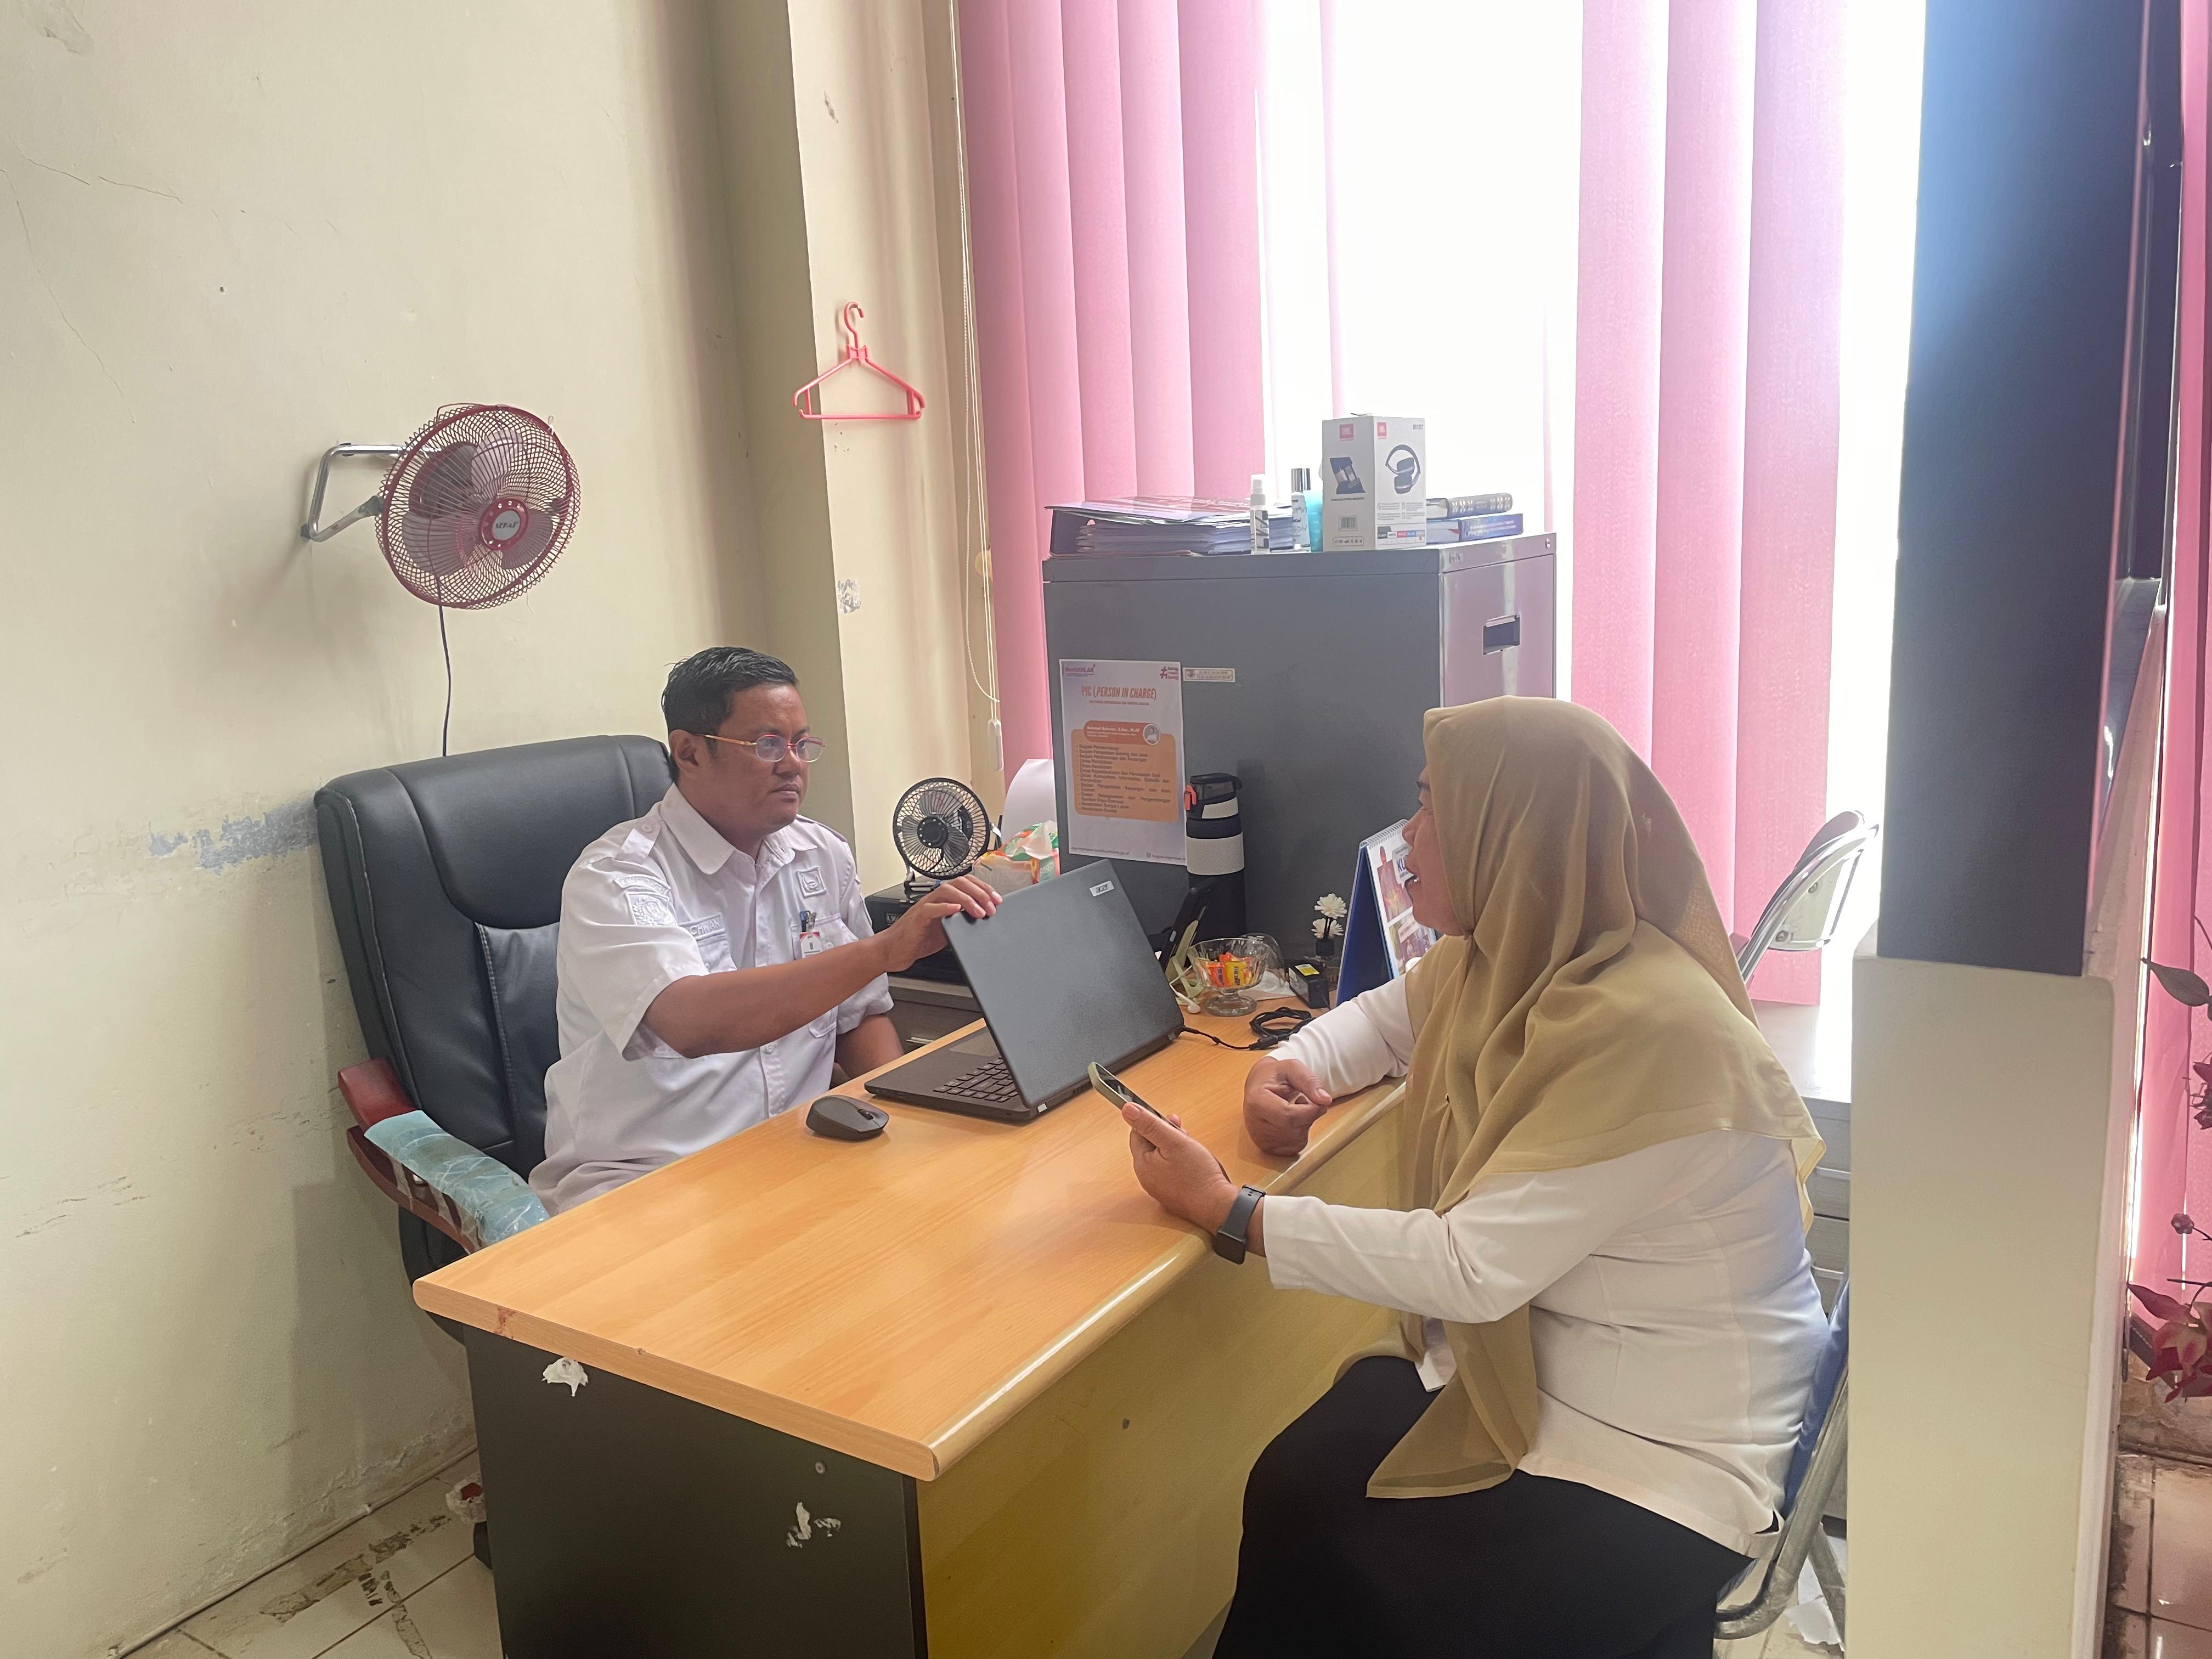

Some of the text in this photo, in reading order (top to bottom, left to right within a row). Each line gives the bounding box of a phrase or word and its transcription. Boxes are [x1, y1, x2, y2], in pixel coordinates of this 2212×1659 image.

[1081, 685, 1092, 696] PIC
[1121, 687, 1128, 698] IN
[1130, 687, 1156, 701] CHARGE)
[1096, 884, 1108, 893] acer
